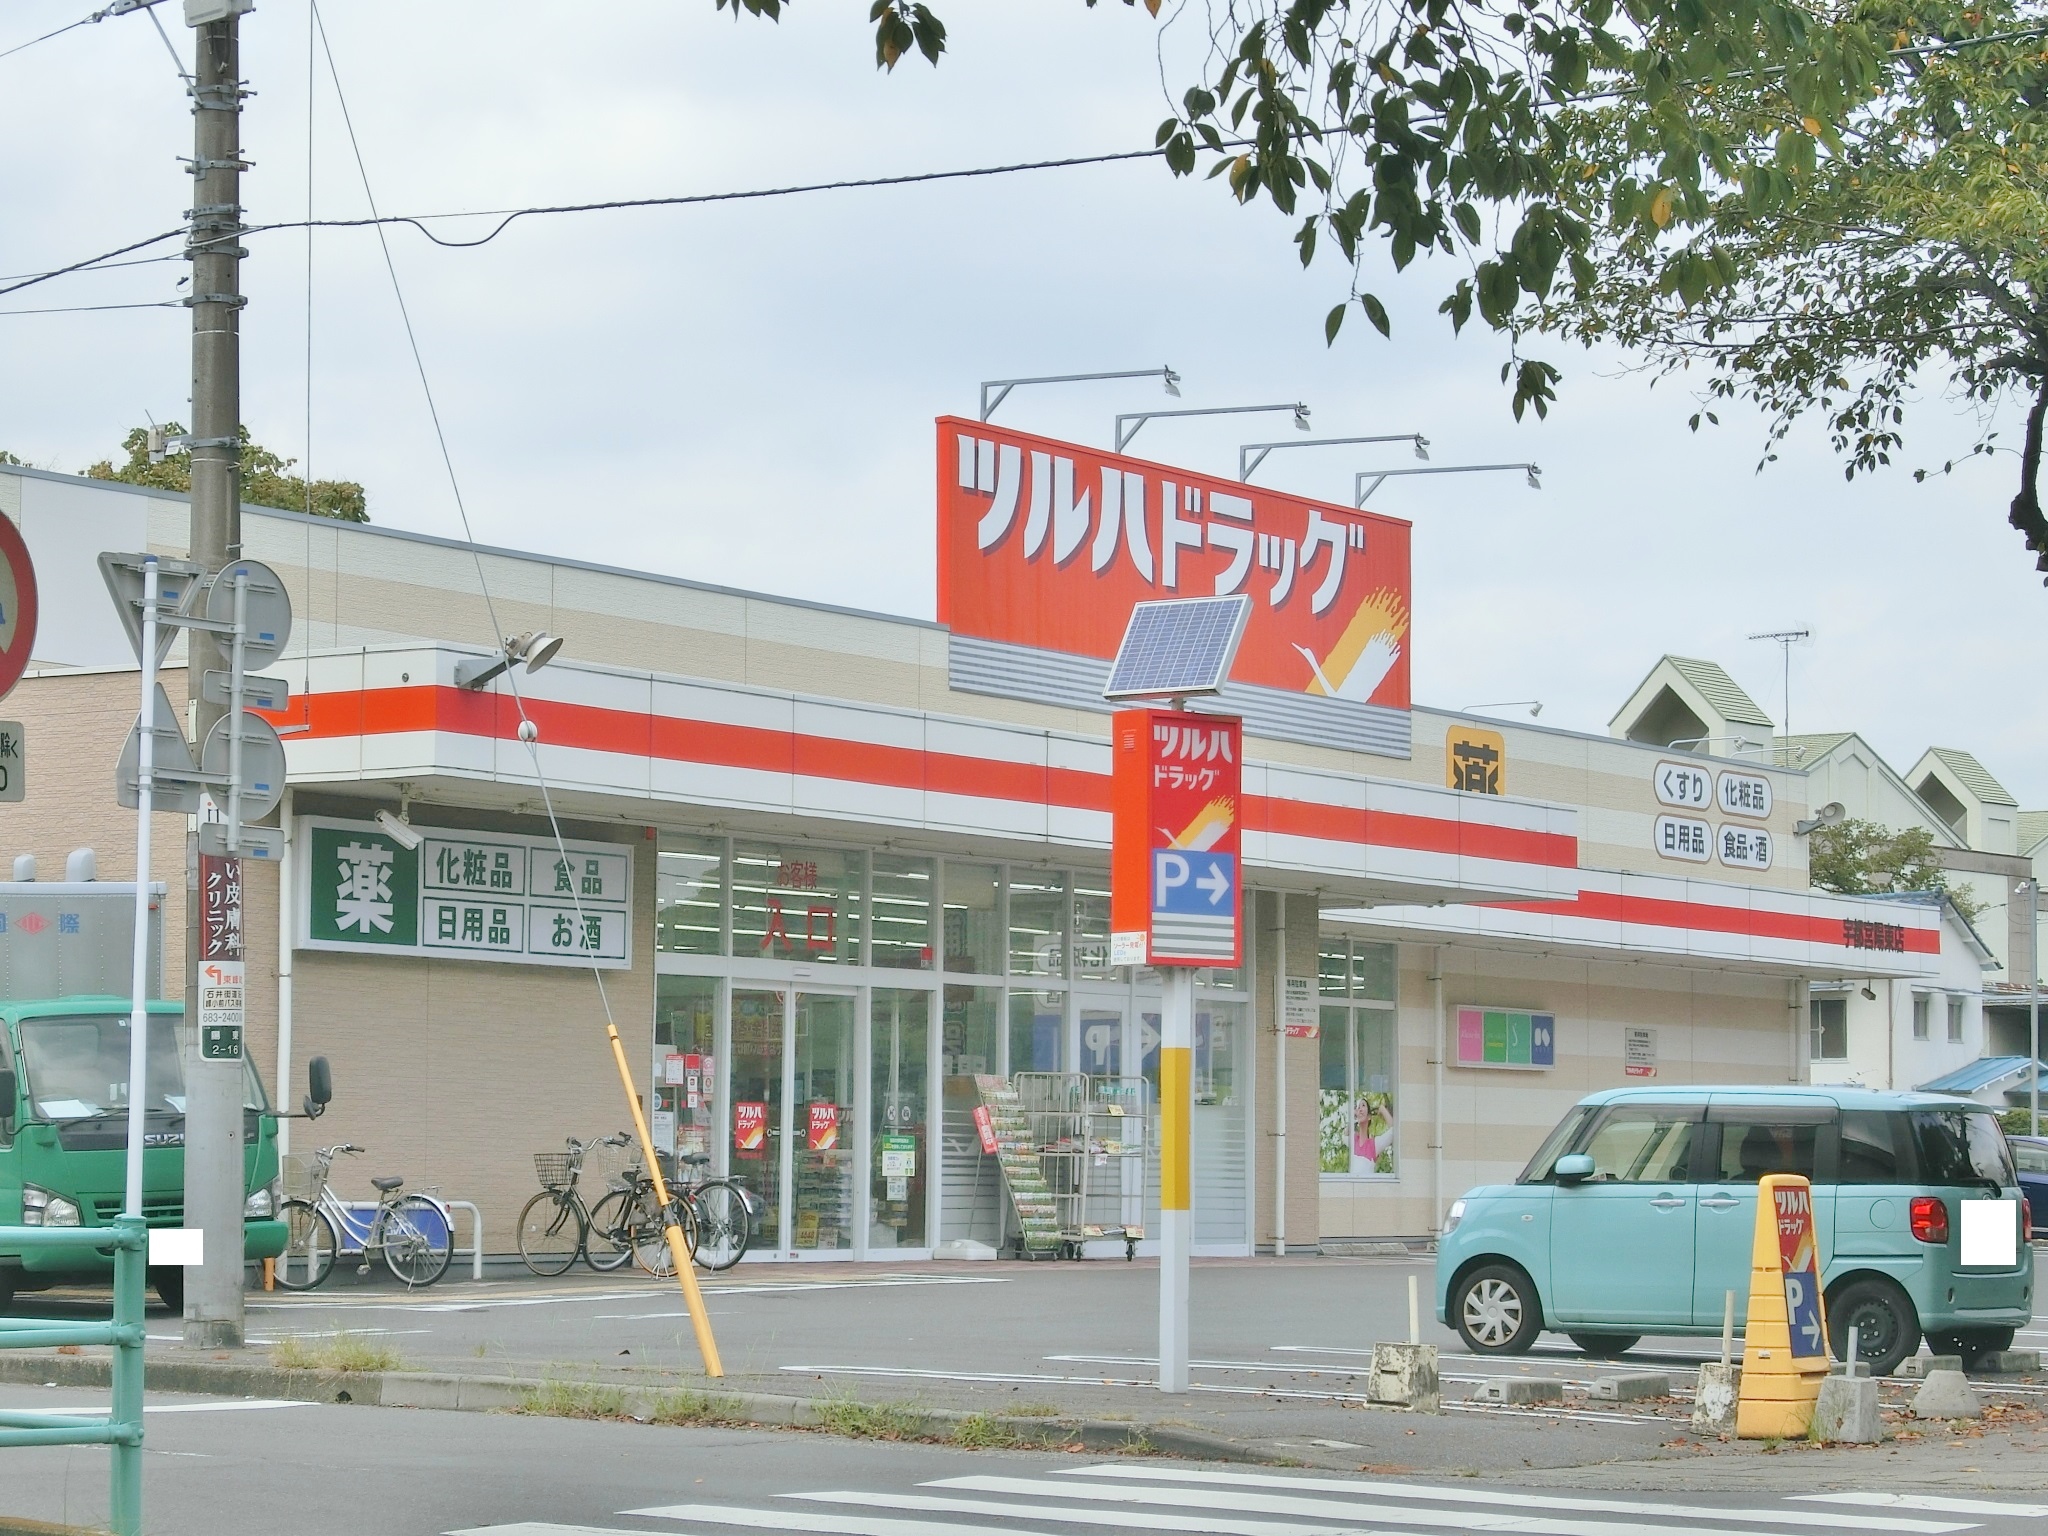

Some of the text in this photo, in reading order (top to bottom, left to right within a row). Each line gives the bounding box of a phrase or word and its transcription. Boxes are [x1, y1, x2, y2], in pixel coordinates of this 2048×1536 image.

[957, 433, 1365, 615] ツルハドラッグ
[1153, 724, 1233, 764] ツルハ
[1154, 764, 1220, 792] ドラッグ
[1453, 740, 1499, 795] 薬
[1663, 769, 1703, 802] くすり
[1724, 778, 1765, 811] 化粧品
[1664, 822, 1705, 854] 日用品
[1723, 830, 1767, 863] 食品・酒
[436, 848, 513, 889] 化粧品
[553, 856, 602, 895] 食品
[776, 860, 818, 890] お客様
[1156, 852, 1190, 908] P
[335, 841, 395, 934] 薬
[206, 872, 224, 957] クリニック
[224, 857, 241, 957] い皮膚科
[760, 897, 835, 951] 入口
[437, 905, 511, 945] 日用品
[551, 913, 602, 951] お酒
[211, 1044, 240, 1056] 2-16
[737, 1105, 763, 1119] ツルハ
[737, 1119, 758, 1129] ドラッグ
[811, 1107, 835, 1121] ツルハ
[811, 1120, 830, 1130] ドラッグ
[1773, 1190, 1811, 1216] ツルハ
[1777, 1218, 1805, 1236] ドラッグ
[1785, 1277, 1804, 1326] P
